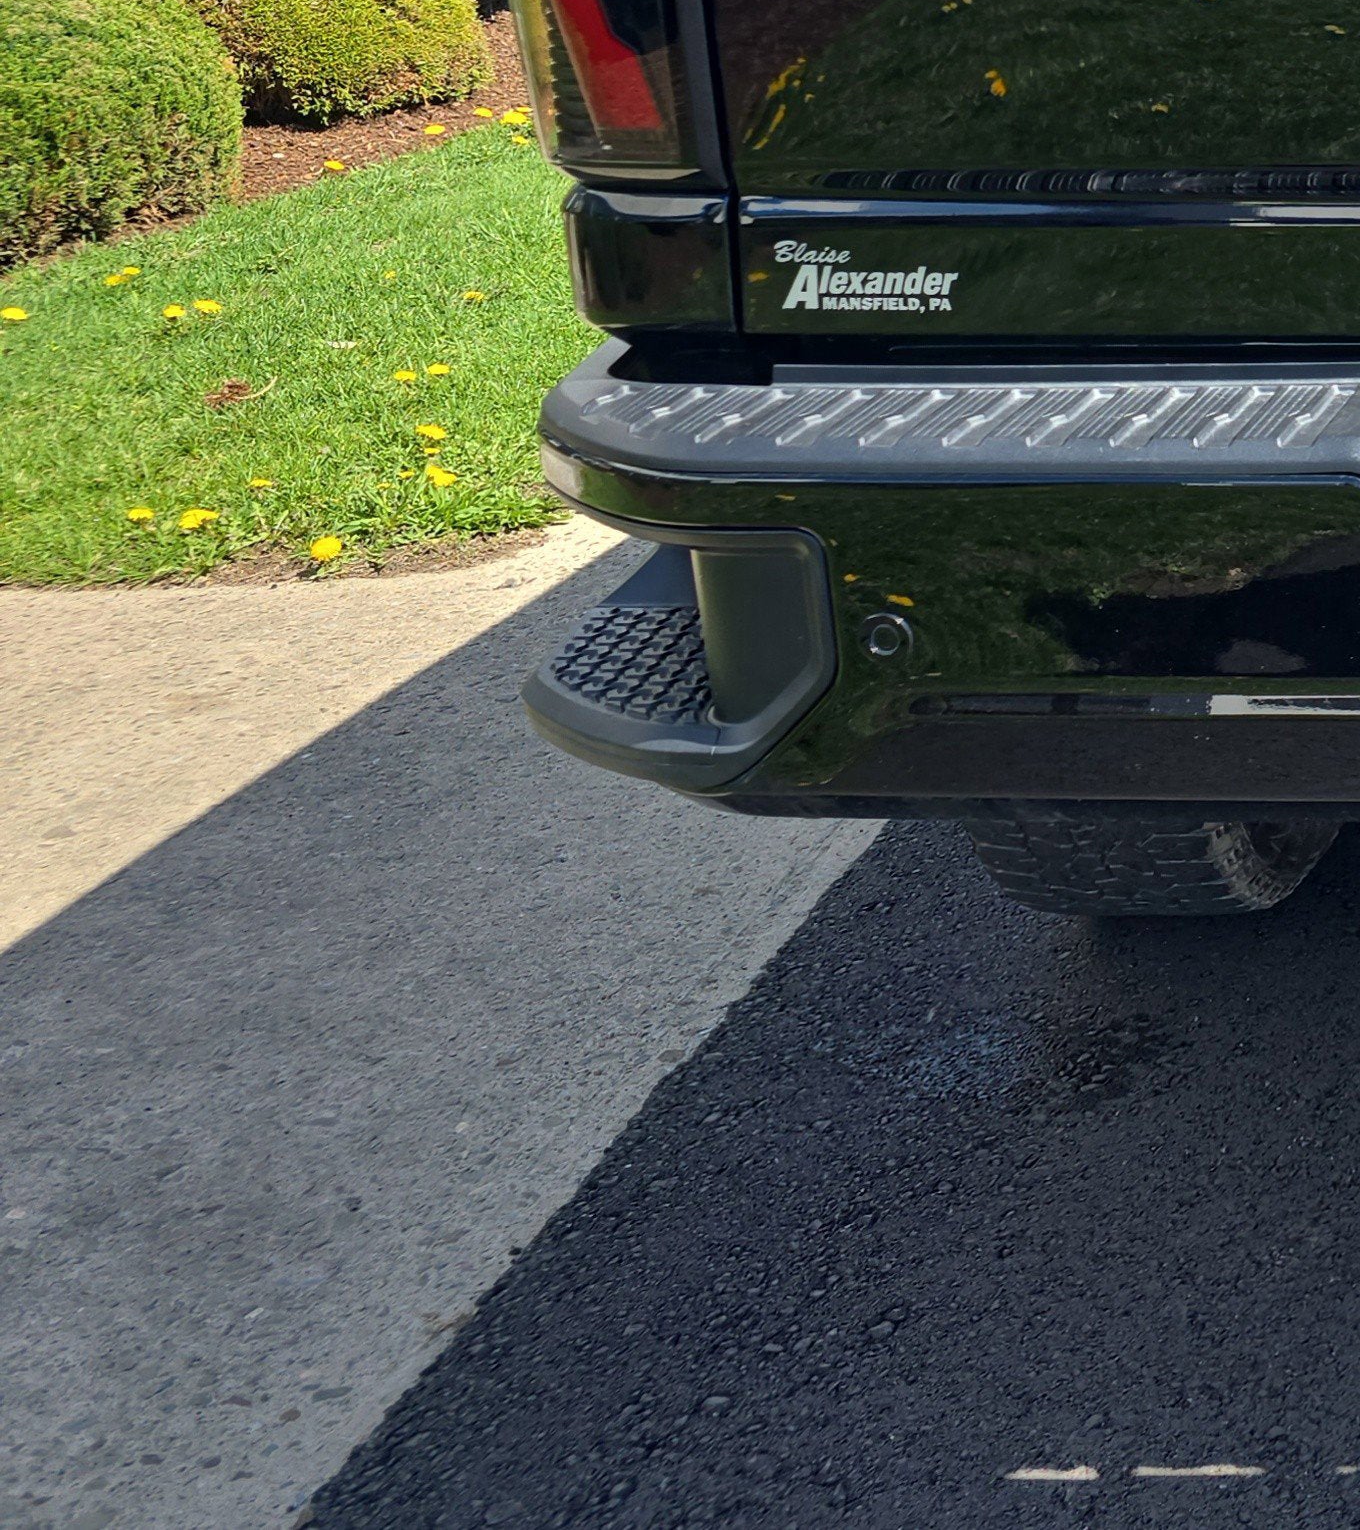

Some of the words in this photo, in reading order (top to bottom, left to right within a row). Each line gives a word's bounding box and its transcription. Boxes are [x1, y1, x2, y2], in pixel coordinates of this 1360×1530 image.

[774, 240, 851, 263] Blaise
[782, 265, 958, 309] Alexander
[822, 297, 927, 313] MANSFIELD,
[930, 297, 952, 311] PA
